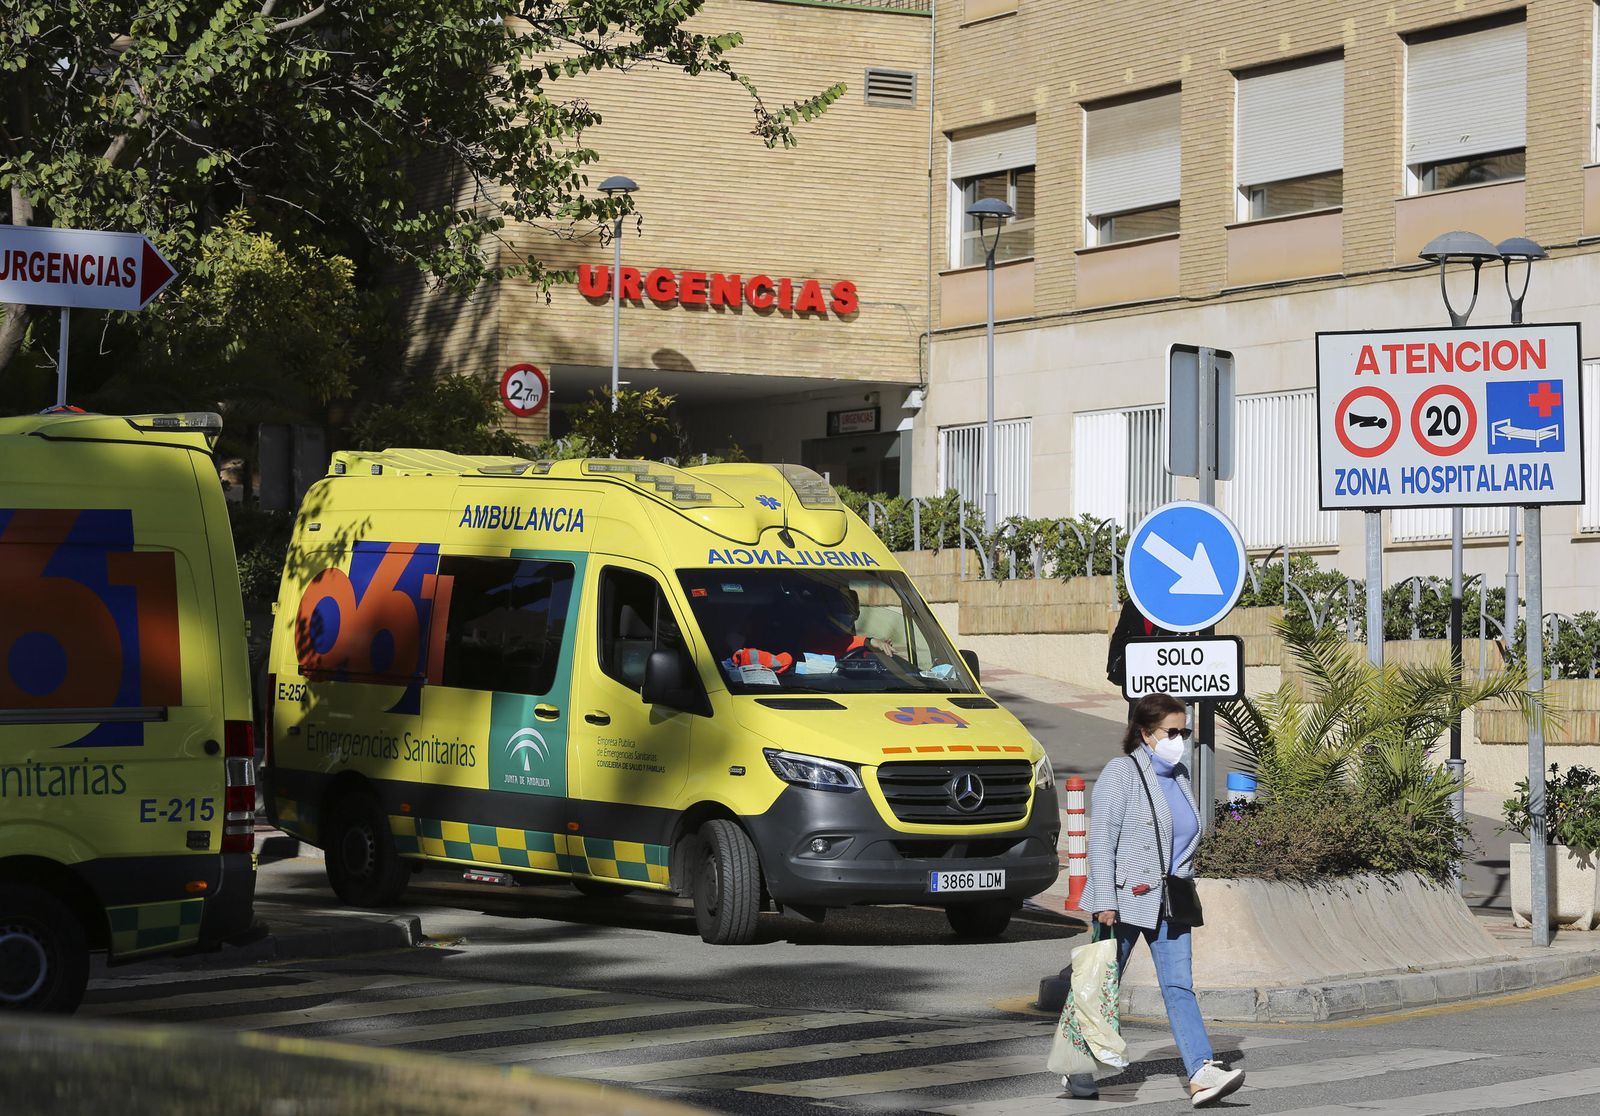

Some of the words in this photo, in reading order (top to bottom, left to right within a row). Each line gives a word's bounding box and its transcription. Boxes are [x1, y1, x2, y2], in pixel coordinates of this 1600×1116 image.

[0, 249, 137, 289] URGENCIAS
[578, 263, 860, 316] URGENCIAS
[1354, 338, 1547, 376] ATENCION
[1425, 404, 1462, 437] 20
[1334, 467, 1391, 496] ZONA
[1401, 462, 1554, 495] HOSPITALARIA
[458, 504, 585, 533] AMBULANCIA
[294, 541, 455, 687] 061
[1156, 647, 1204, 666] SOLO
[278, 682, 307, 702] E-252
[1131, 673, 1230, 694] URGENCIAS
[307, 723, 399, 764] Emergencias
[404, 732, 476, 768] Sanitarias
[140, 797, 215, 823] E-215
[942, 874, 974, 889] 3866
[979, 872, 1002, 888] LDM
